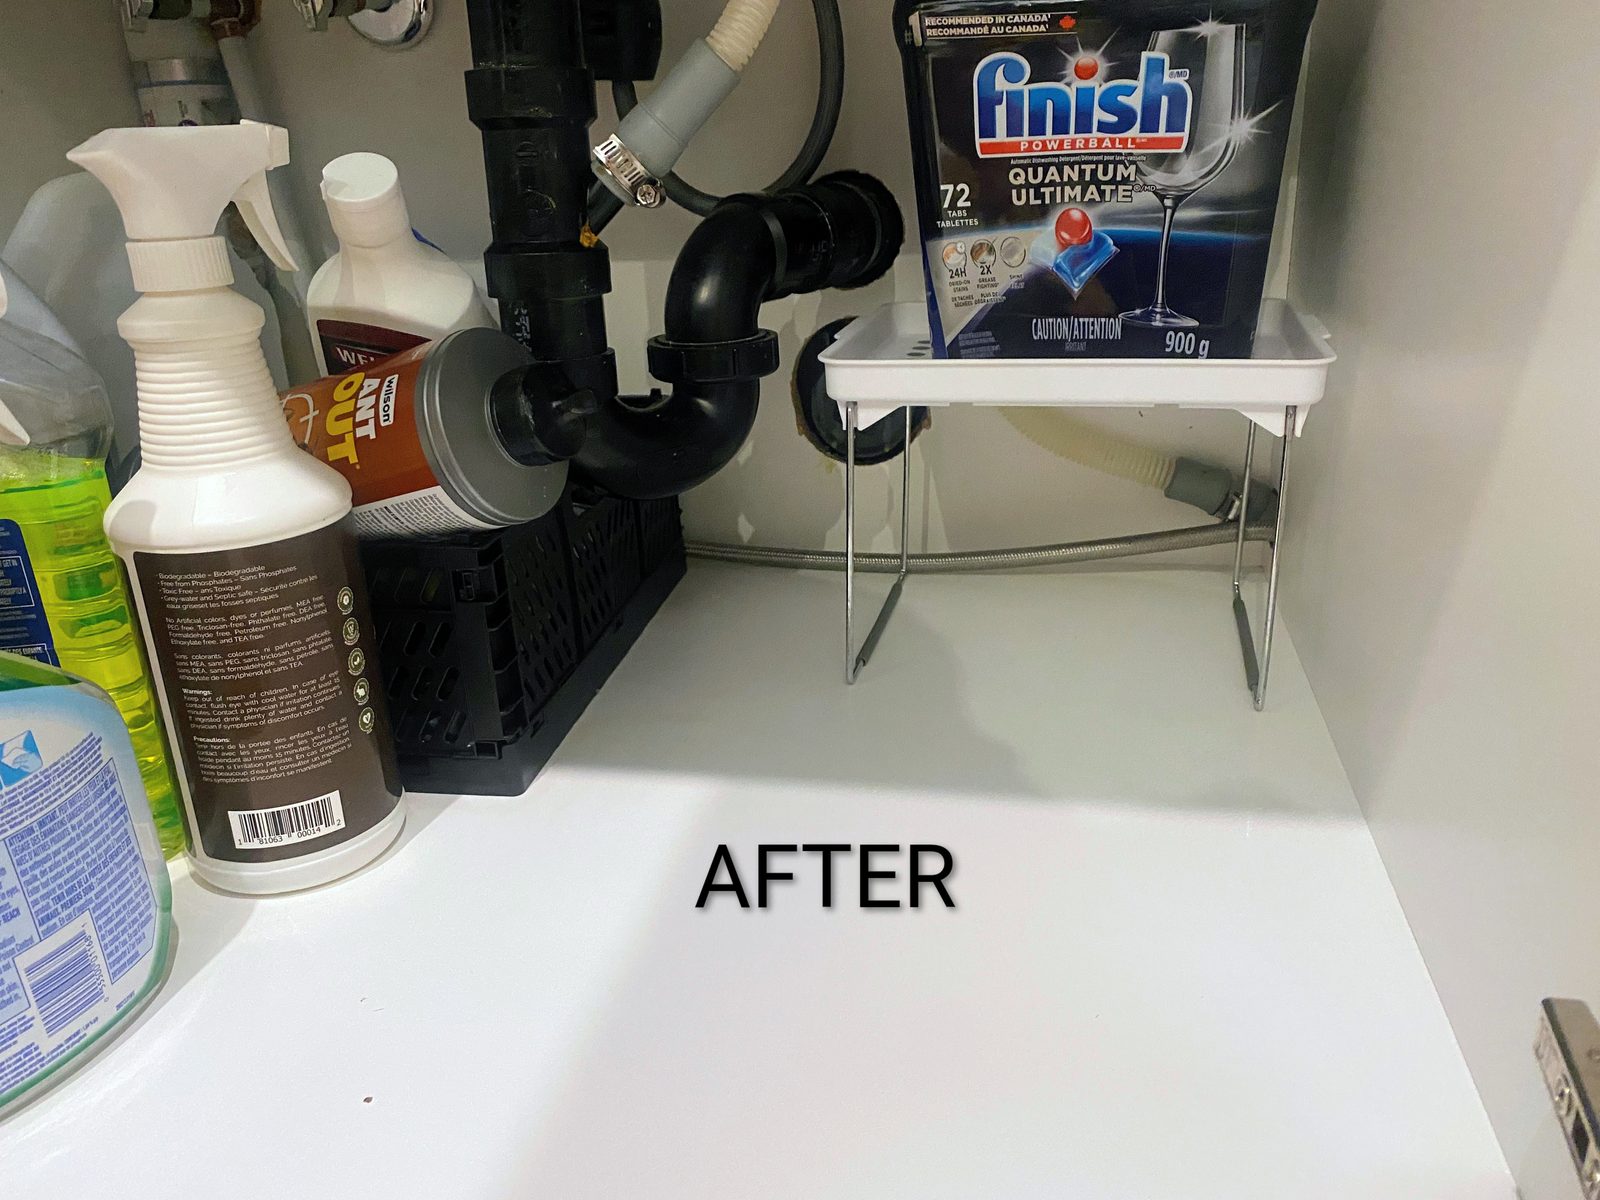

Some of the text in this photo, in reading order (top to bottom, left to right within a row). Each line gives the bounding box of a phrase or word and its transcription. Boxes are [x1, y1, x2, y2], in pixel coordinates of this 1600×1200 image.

[925, 16, 994, 26] RECOMMENDED
[994, 15, 1006, 24] IN
[926, 25, 990, 36] RECOMMANDÉ
[991, 26, 1004, 34] AU
[974, 53, 1191, 140] finish
[1020, 137, 1136, 151] POWERBALL
[1008, 164, 1137, 185] QUANTUM
[940, 183, 971, 208] 72
[1011, 184, 1133, 206] ULTIMATE
[936, 218, 979, 228] TABLETTES
[948, 267, 967, 279] 24H
[979, 265, 992, 275] 2X
[1032, 316, 1122, 342] CAUTION/ATTENTION
[1165, 331, 1210, 359] 900 g
[355, 378, 381, 440] ANT
[325, 371, 366, 464] OUT
[191, 578, 233, 586] Phosphates
[258, 566, 297, 579] Phosphates
[213, 565, 266, 578] Biodegradable
[214, 593, 237, 601] Septic
[221, 599, 245, 607] fosses
[229, 614, 248, 622] dyes
[234, 624, 271, 635] Petroleum
[233, 635, 249, 643] TEA
[227, 649, 260, 658] colorants
[274, 639, 302, 651] parfums
[242, 656, 260, 664] sans
[279, 656, 295, 665] sans
[272, 665, 289, 673] sans
[302, 678, 317, 687] case
[319, 674, 326, 682] of
[181, 687, 213, 696] Warnings:
[243, 699, 259, 707] with
[261, 696, 277, 704] cool
[278, 691, 297, 701] water
[243, 713, 266, 722] plenty
[278, 706, 297, 715] water
[300, 701, 313, 710] and
[246, 703, 279, 714] physician
[222, 721, 258, 730] symptoms
[267, 712, 303, 725] discomfort
[7, 824, 34, 847] ATTENTION
[258, 836, 284, 845] 81063
[297, 826, 321, 839] 00014
[84, 935, 98, 963] 01168
[94, 963, 106, 990] 55500
